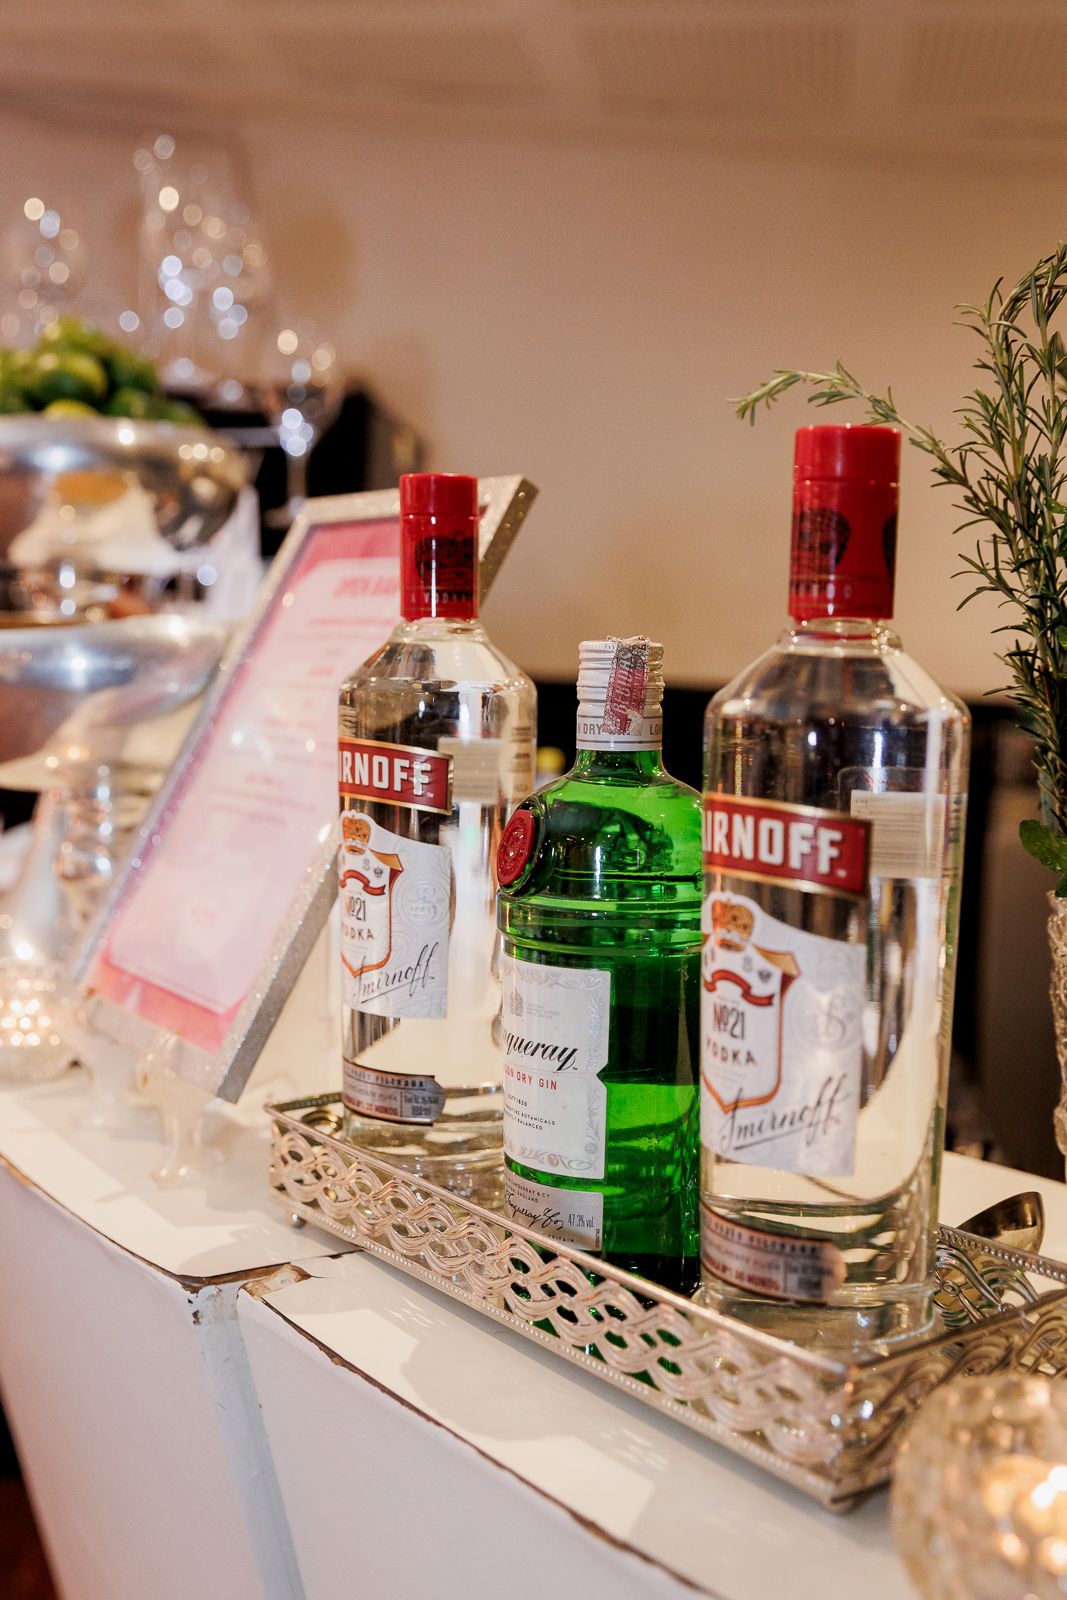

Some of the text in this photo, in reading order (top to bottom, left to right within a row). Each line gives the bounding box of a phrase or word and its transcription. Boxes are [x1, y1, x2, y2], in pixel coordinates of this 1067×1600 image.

[583, 723, 602, 735] DRY
[516, 1071, 533, 1084] DRY
[538, 1078, 557, 1090] GIN
[517, 1118, 543, 1131] BALANCED
[521, 1112, 556, 1126] BOTANICALS
